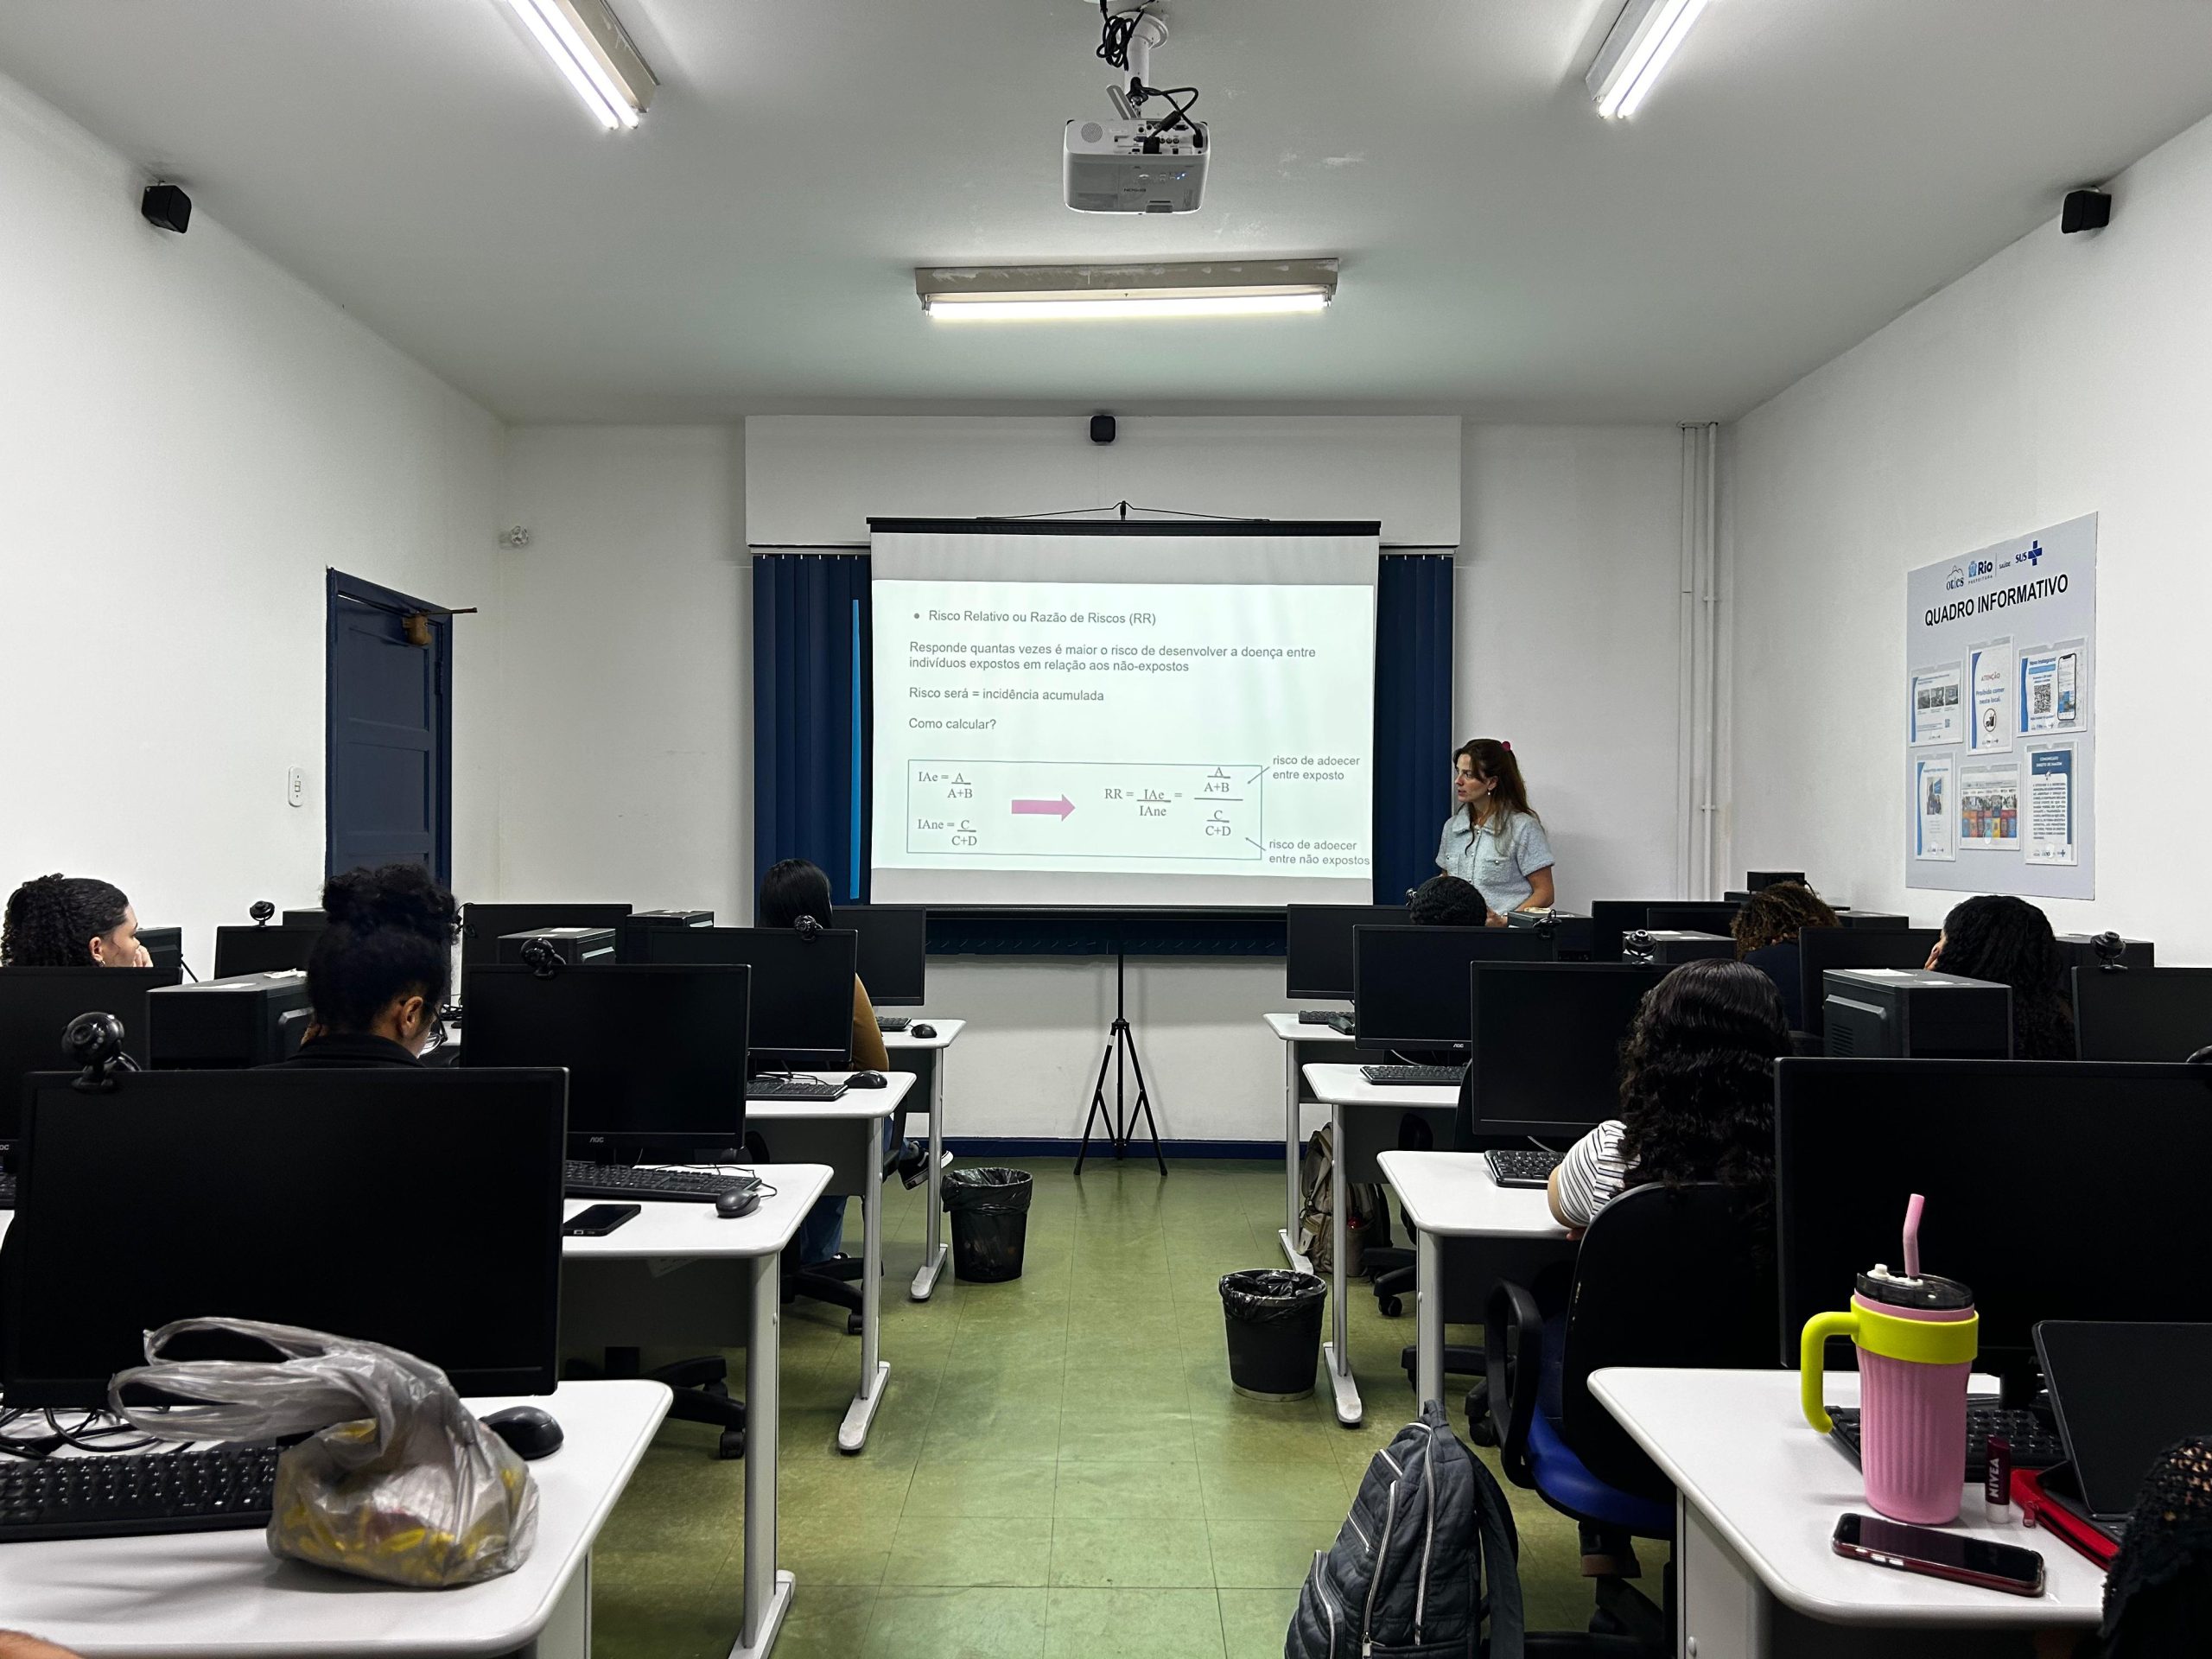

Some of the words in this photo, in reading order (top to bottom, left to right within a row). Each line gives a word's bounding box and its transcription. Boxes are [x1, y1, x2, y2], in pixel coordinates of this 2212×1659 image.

[2015, 552, 2027, 563] SUS
[1977, 561, 1993, 575] Rio
[1925, 599, 1974, 626] QUADRO
[1978, 574, 2068, 613] INFORMATIVO
[929, 610, 960, 621] Risco
[964, 611, 1009, 622] Relativo
[1013, 613, 1027, 622] ou
[1031, 612, 1066, 622] Razão
[1070, 613, 1084, 623] de
[1088, 613, 1125, 623] Riscos
[1129, 613, 1156, 626] (RR)
[910, 641, 967, 655] Responde
[970, 644, 1015, 655] quantas
[1055, 644, 1062, 654] é
[1066, 645, 1097, 655] maior
[1111, 645, 1138, 655] risco
[1141, 645, 1155, 656] de
[1159, 646, 1227, 657] desenvolver
[1242, 646, 1282, 659] doença
[1287, 648, 1316, 657] entre
[909, 657, 966, 668] indivíduos
[969, 658, 1020, 671] expostos
[1045, 660, 1086, 672] relação
[1090, 662, 1109, 671] aos
[1113, 661, 1189, 673] não-expostos
[909, 688, 940, 698] Risco
[944, 689, 968, 698] será
[983, 689, 1039, 700] incidência
[1043, 690, 1103, 701] acumulada
[909, 718, 942, 728] Como
[946, 719, 996, 729] calcular?
[1273, 756, 1298, 766] risco
[1301, 756, 1314, 766] de
[1318, 756, 1360, 766] adoecer
[918, 772, 938, 781] IAe
[955, 772, 963, 782] A
[1214, 766, 1224, 777] A
[1303, 772, 1344, 781] exposto
[1204, 783, 1230, 792] A+B
[948, 789, 973, 798] A+B
[1105, 789, 1122, 798] RR
[1144, 789, 1164, 799] IAe
[1140, 806, 1166, 817] IAne
[1214, 810, 1223, 820] C
[918, 819, 944, 830] IAne
[961, 820, 969, 830] C
[1205, 826, 1230, 836] C+D
[951, 836, 976, 846] C+D
[1269, 840, 1294, 849] risco
[1298, 840, 1310, 849] de
[1313, 841, 1357, 850] adoecer
[1269, 855, 1296, 864] entre
[1300, 855, 1319, 864] não
[1322, 856, 1370, 867] expostos
[1989, 1459, 1999, 1497] NIVEA
